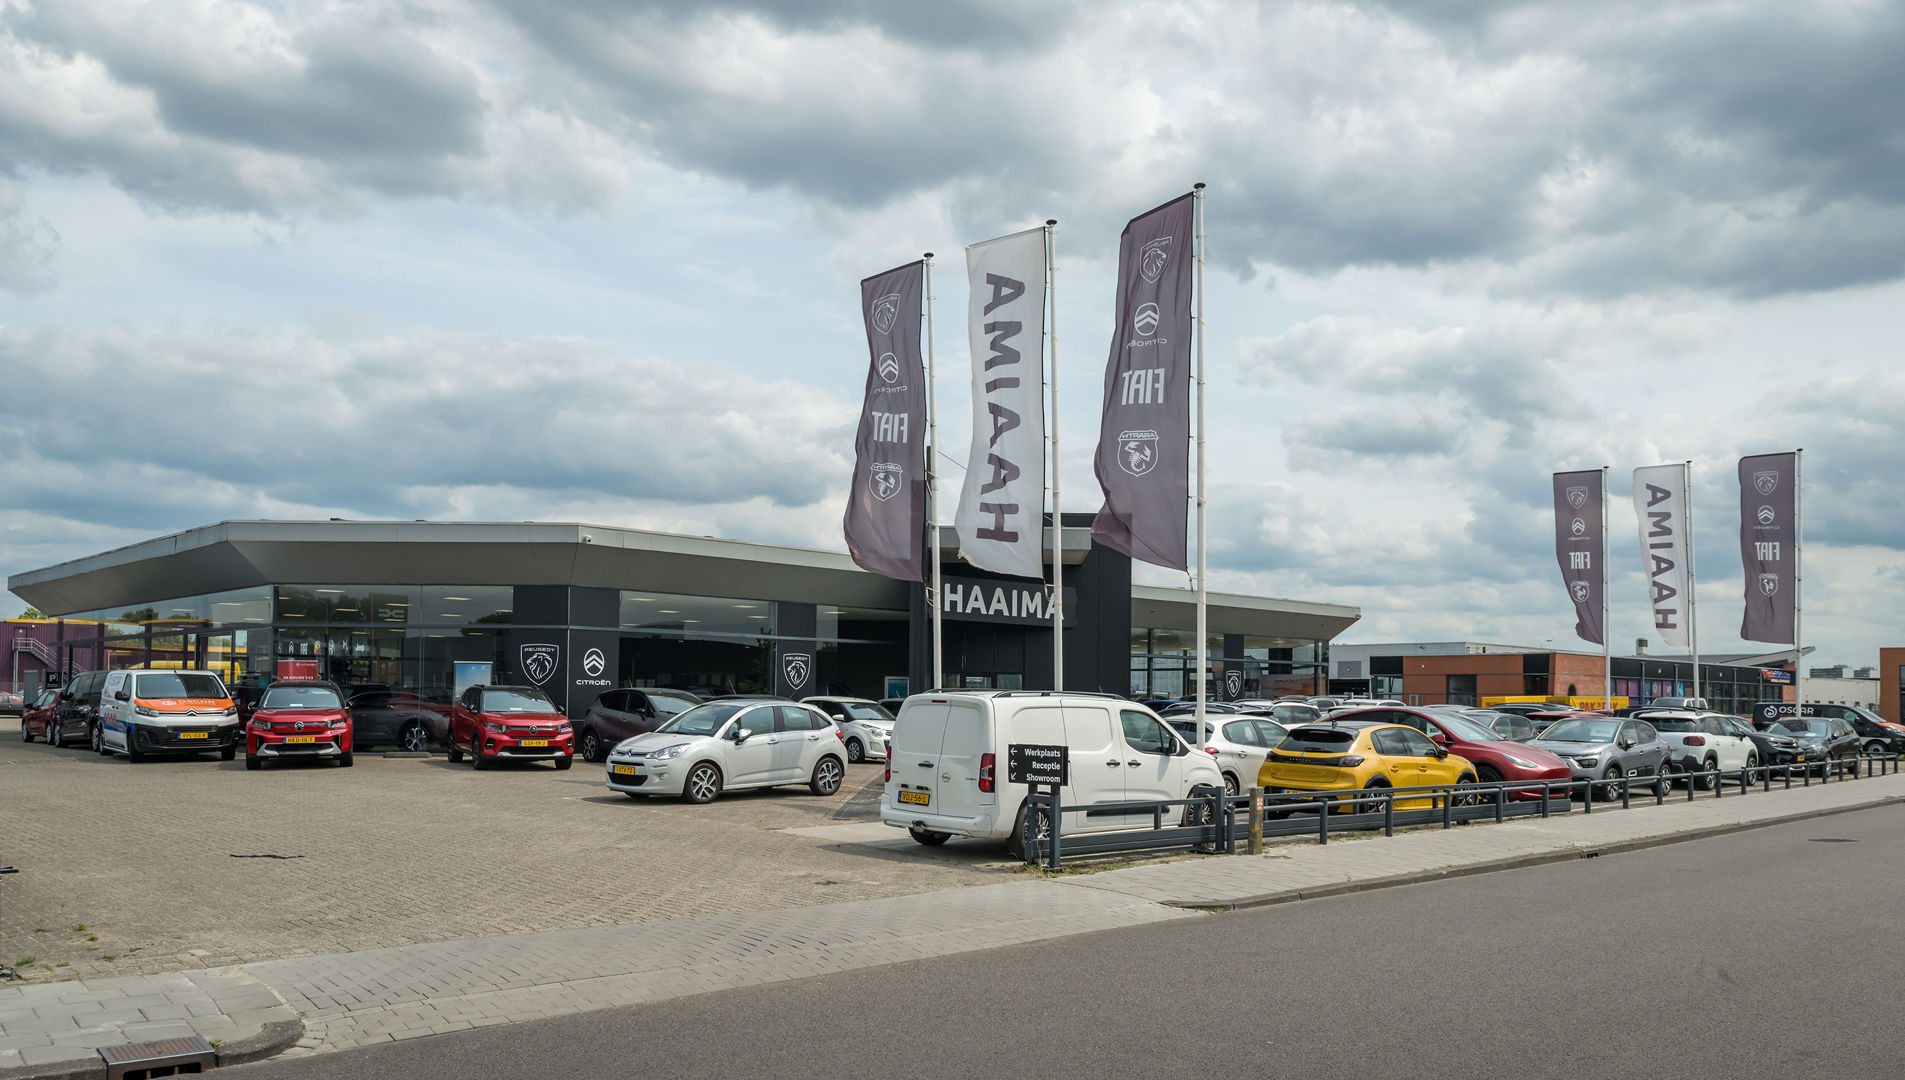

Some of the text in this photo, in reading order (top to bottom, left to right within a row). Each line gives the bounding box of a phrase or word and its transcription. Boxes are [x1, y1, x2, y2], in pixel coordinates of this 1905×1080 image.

[944, 583, 1064, 620] HAAIMA
[1024, 748, 1060, 758] Werkplaats
[1032, 761, 1060, 771] Receptie
[1026, 773, 1060, 783] Showroom
